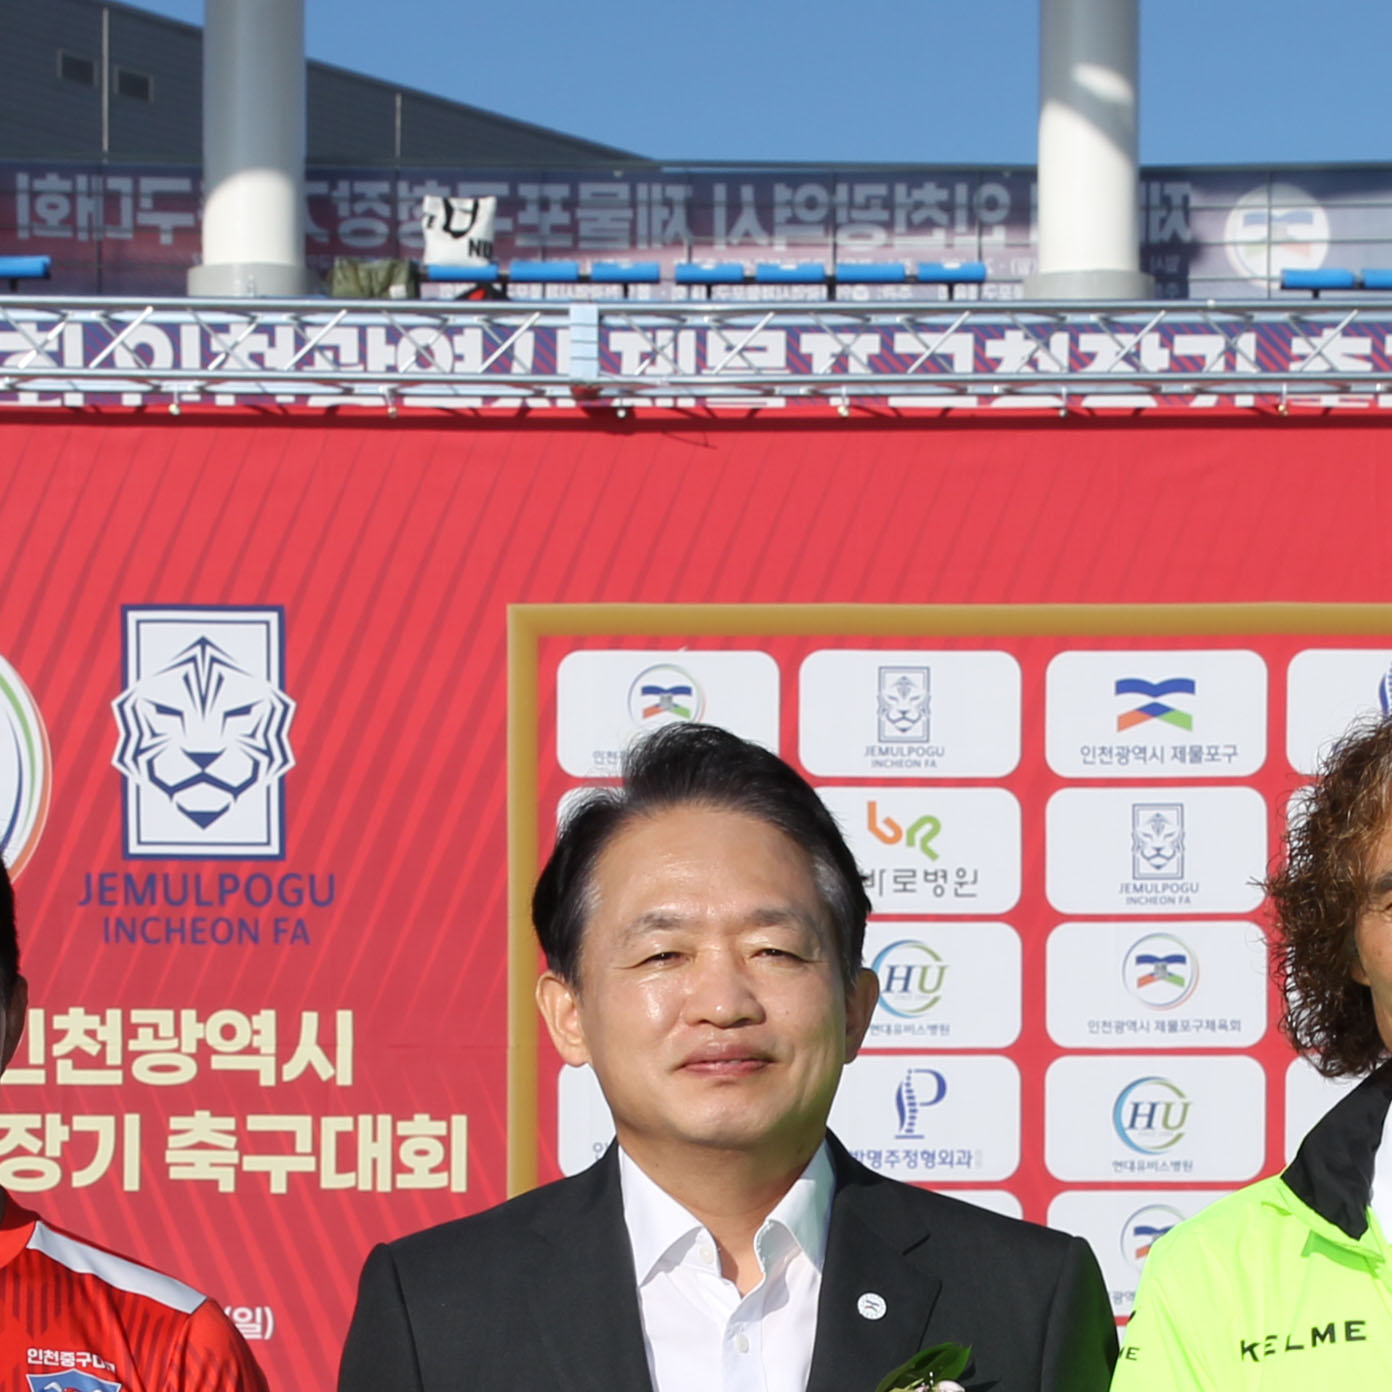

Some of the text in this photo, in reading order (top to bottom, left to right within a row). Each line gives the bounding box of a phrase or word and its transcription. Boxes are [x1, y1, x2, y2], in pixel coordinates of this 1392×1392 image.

[864, 745, 946, 758] JEMULPOGU
[871, 759, 938, 769] INCHEON FA
[1080, 744, 1240, 766] 인천광역시 제물포구
[78, 872, 336, 909] JEMULPOGU
[1118, 882, 1200, 894] JEMULPOGU
[1126, 895, 1192, 906] INCHEON FA
[103, 917, 310, 946] INCHEON FA
[881, 963, 950, 995] HU
[1087, 1018, 1243, 1035] 인천광역시 제물포구체육회
[1124, 1100, 1193, 1131] HU
[164, 1110, 469, 1195] 축구대회
[1240, 1320, 1367, 1363] KELME
